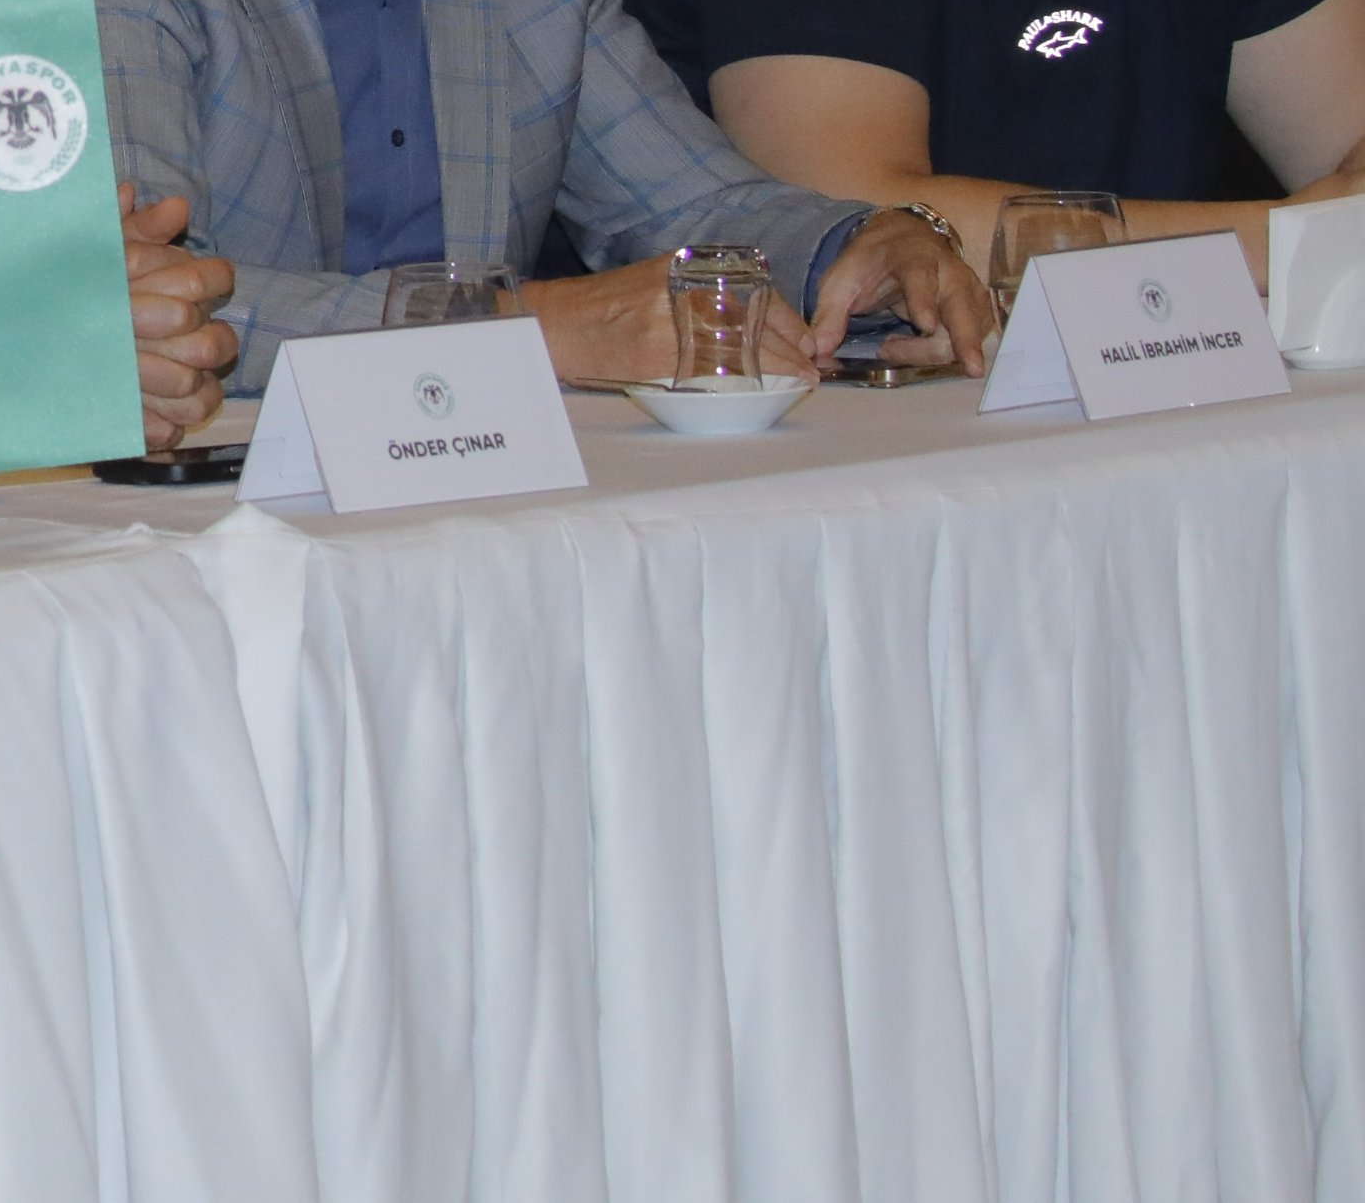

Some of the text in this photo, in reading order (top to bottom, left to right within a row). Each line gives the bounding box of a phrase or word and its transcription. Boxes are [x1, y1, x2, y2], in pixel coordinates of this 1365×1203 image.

[1101, 331, 1243, 364] HALİL İBRAHİM İNCER
[388, 433, 506, 460] ÖNDER ÇINAR
